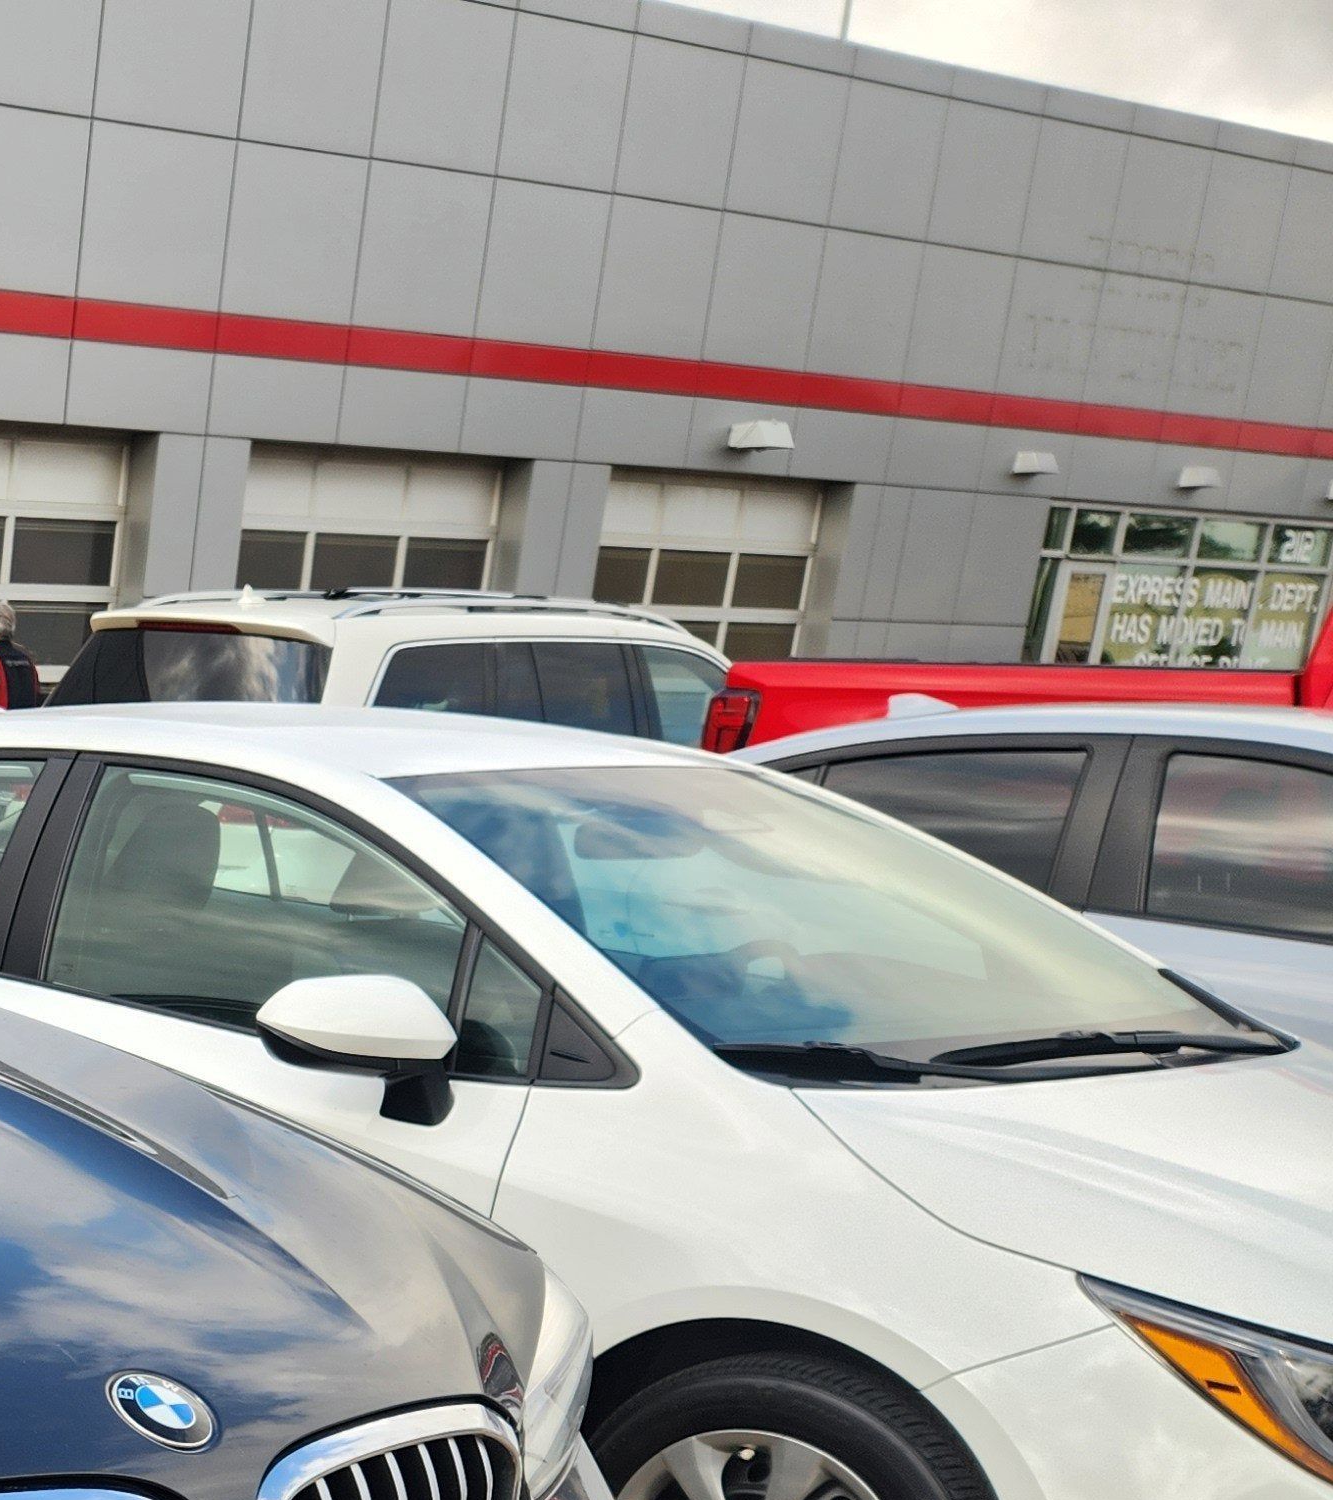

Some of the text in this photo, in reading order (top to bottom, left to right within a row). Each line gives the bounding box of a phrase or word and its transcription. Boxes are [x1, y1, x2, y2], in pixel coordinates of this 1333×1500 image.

[1112, 574, 1319, 613] EXPRESS MAIN. DEPT.
[1110, 612, 1153, 644] HAS
[1258, 620, 1305, 649] MAIN
[118, 1375, 180, 1400] BMW
